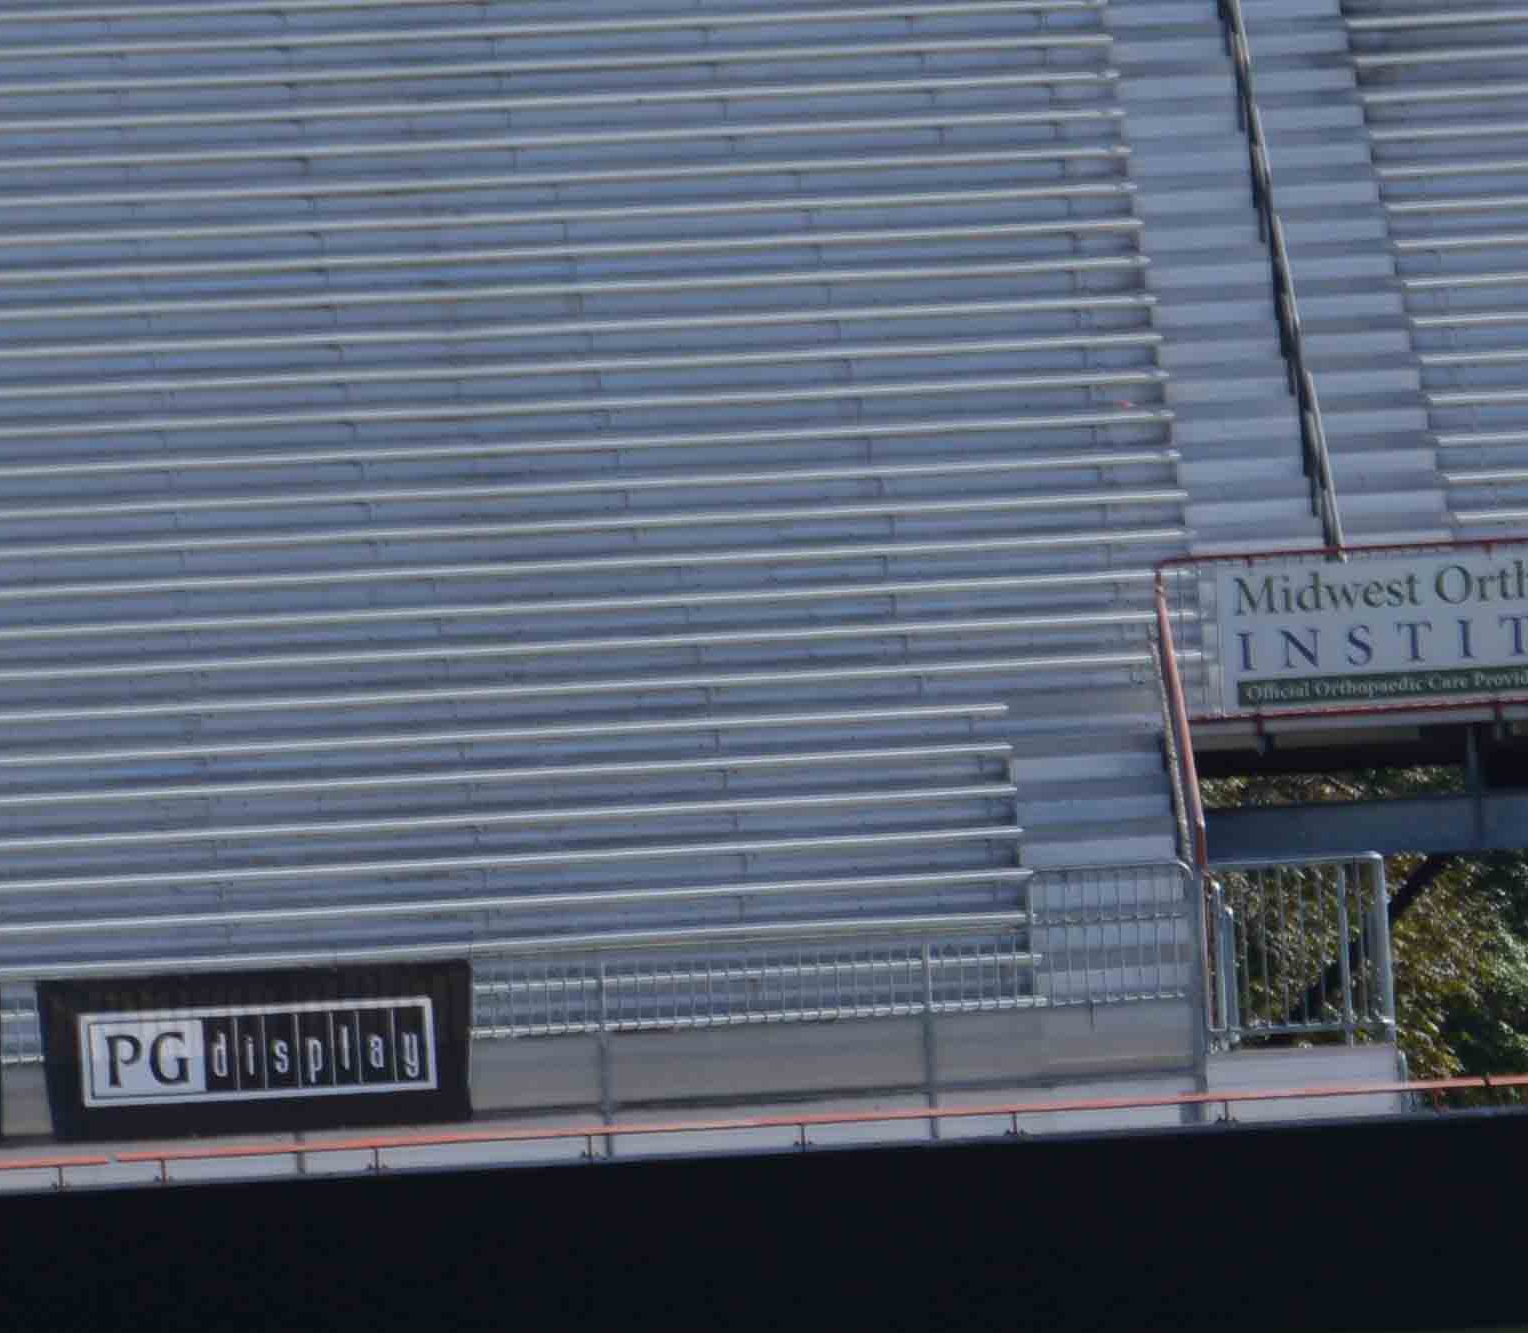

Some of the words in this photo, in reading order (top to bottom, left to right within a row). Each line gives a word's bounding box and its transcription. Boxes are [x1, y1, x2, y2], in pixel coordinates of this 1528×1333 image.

[1233, 570, 1422, 617] Midwest
[104, 1030, 191, 1088] PG
[212, 1025, 418, 1083] display
